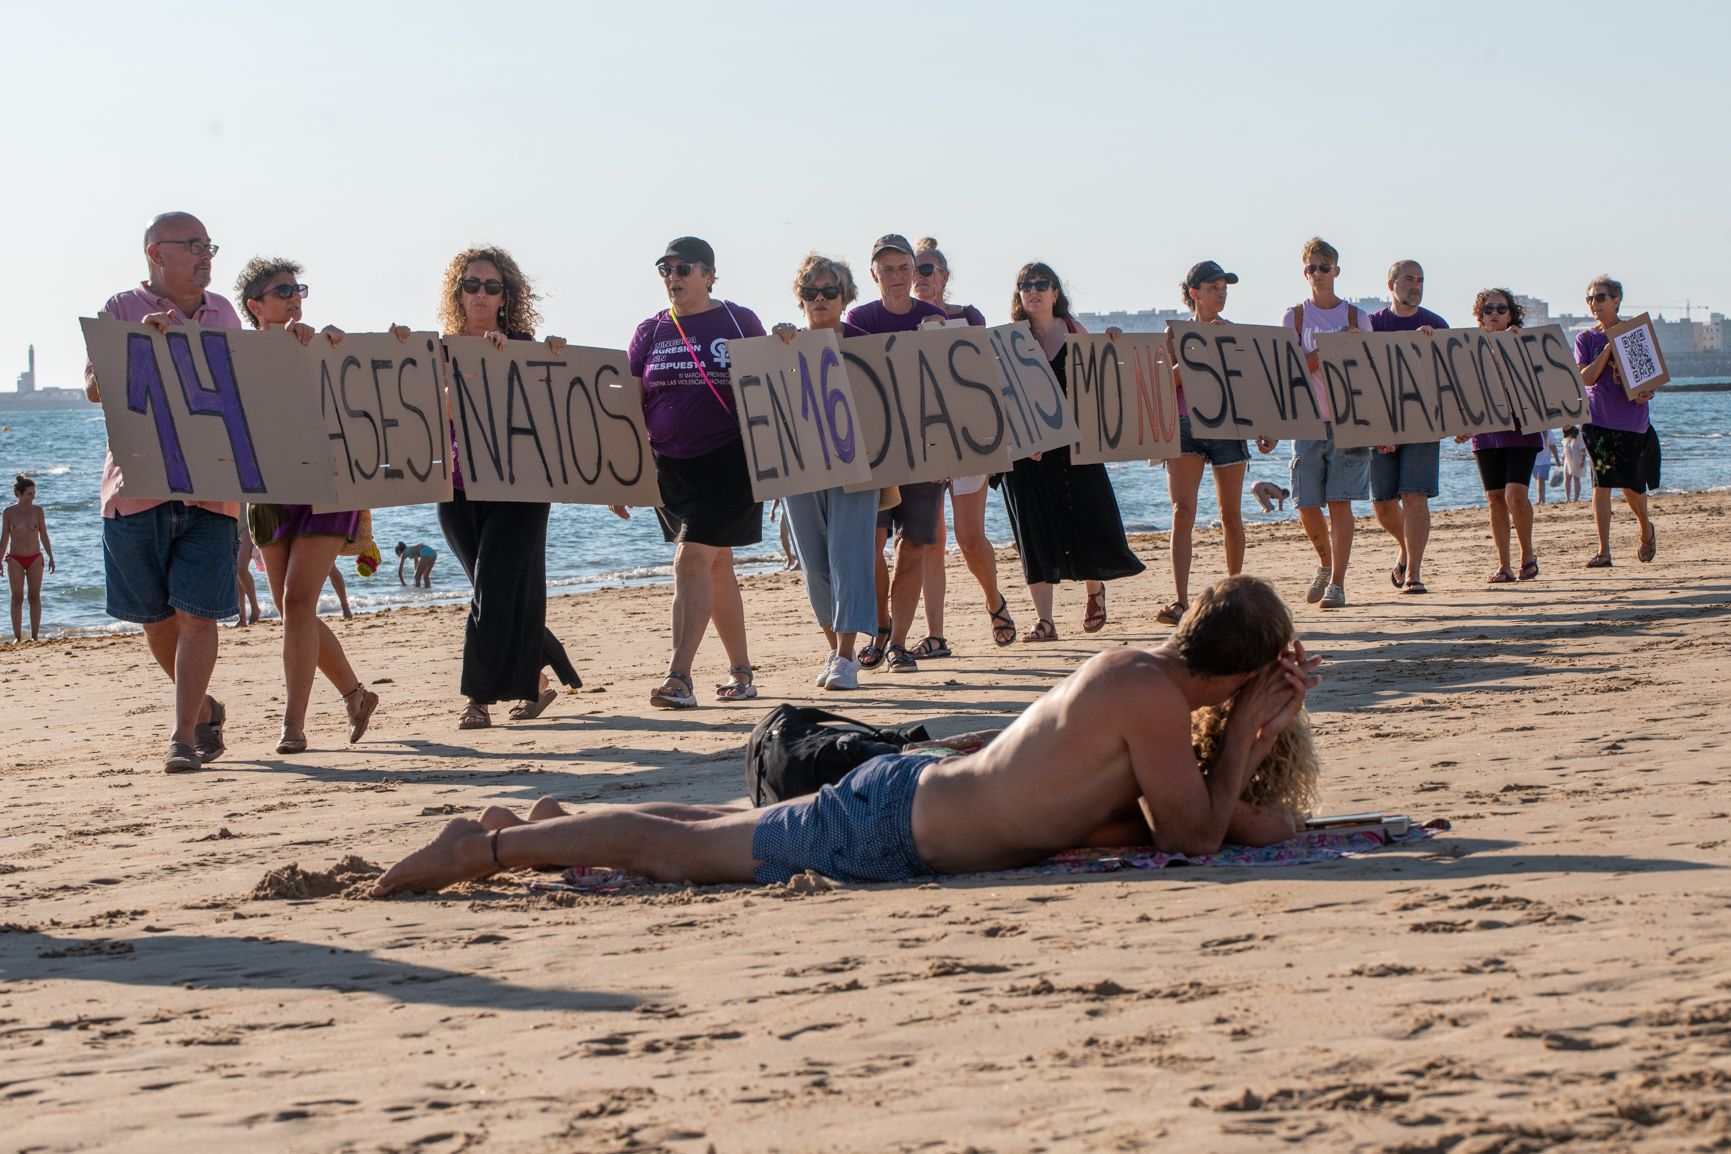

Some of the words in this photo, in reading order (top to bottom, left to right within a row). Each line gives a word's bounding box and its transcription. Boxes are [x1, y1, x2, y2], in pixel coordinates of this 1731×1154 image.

[127, 331, 267, 493] 14
[739, 370, 805, 482] EN
[798, 346, 856, 471] 16
[839, 335, 1004, 470] DÍAS
[1133, 344, 1177, 445] NO
[1179, 331, 1253, 428] SE
[1252, 337, 1320, 421] VA
[1322, 359, 1371, 426] DE
